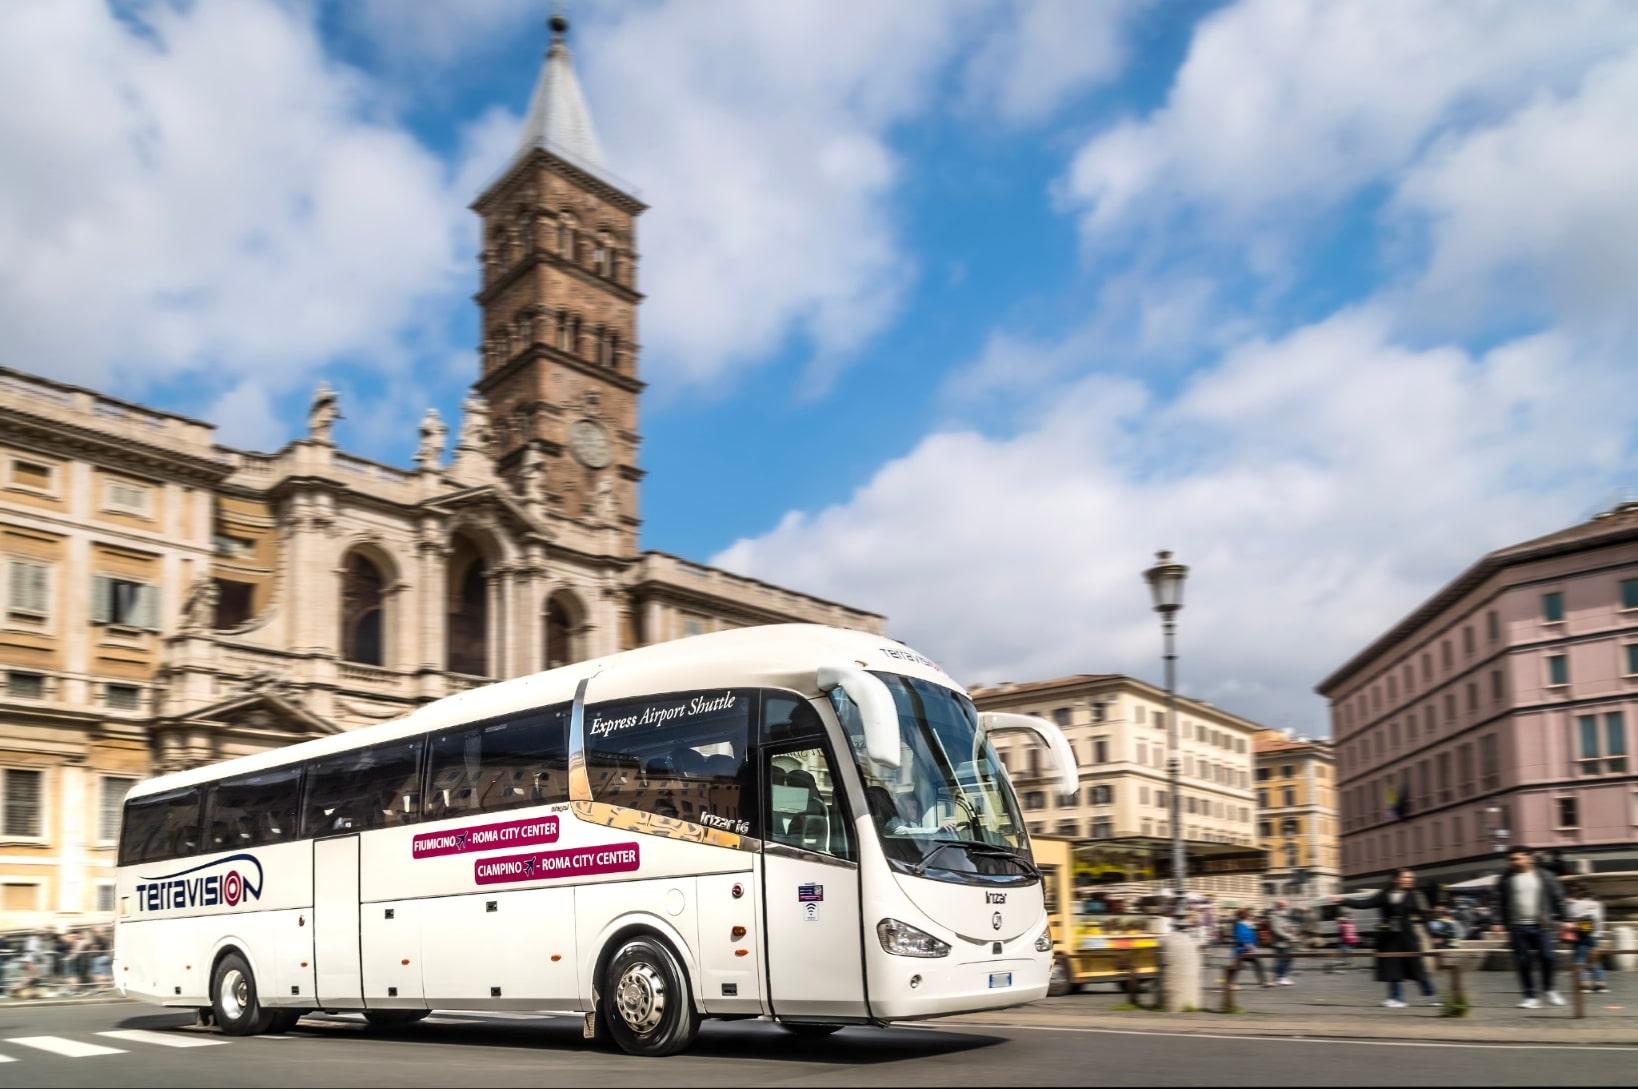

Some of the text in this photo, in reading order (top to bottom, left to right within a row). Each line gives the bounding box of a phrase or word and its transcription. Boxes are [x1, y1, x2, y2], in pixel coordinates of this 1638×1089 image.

[589, 691, 736, 737] Express Airport Shuttle
[414, 835, 456, 852] FIUMICINO
[472, 830, 499, 844] ROMA
[500, 826, 520, 840] CITY
[521, 822, 557, 838] CENTER
[477, 861, 522, 877] CIAMPINO
[542, 858, 571, 871] ROMA
[572, 854, 595, 867] CITY
[597, 849, 636, 865] CENTER
